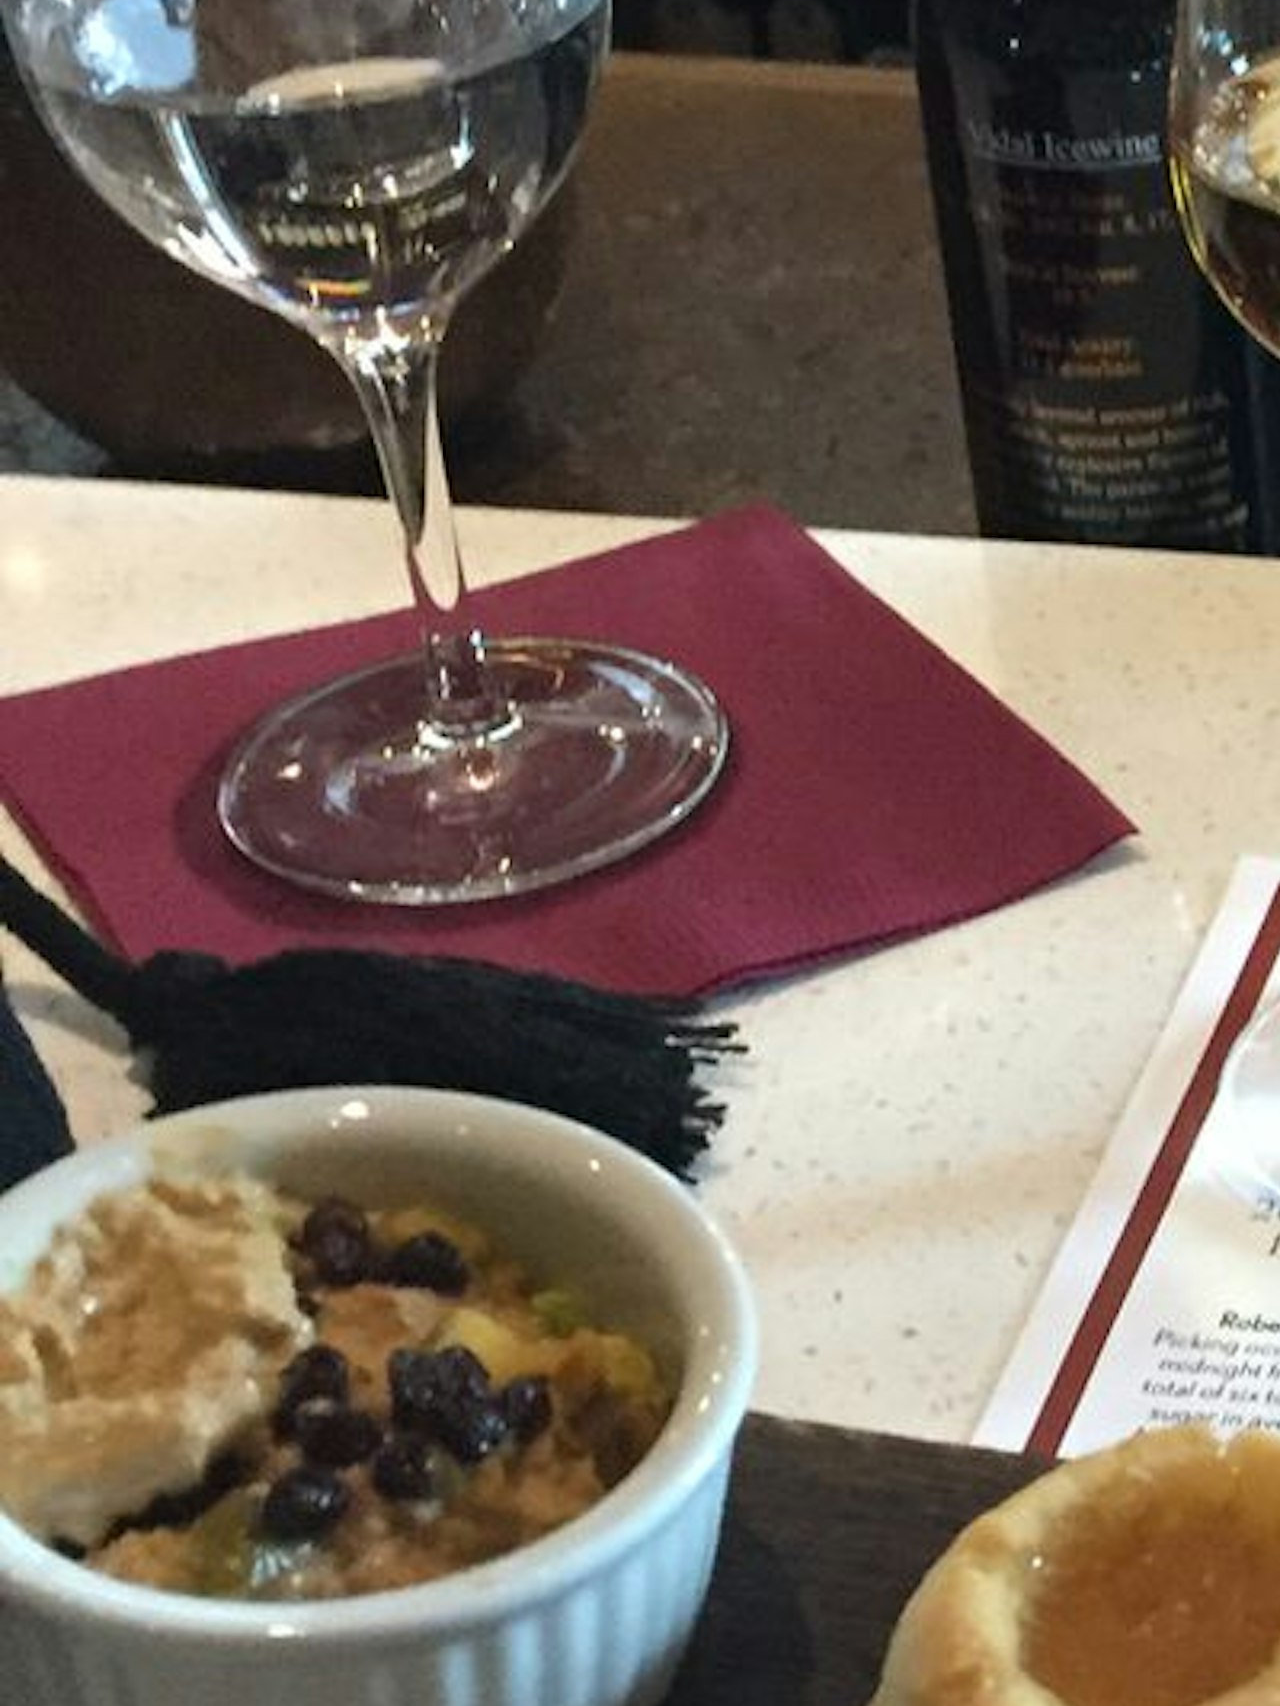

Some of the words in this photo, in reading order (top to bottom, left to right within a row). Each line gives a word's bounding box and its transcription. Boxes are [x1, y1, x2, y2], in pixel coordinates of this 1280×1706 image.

[1043, 131, 1161, 162] Icewine
[1153, 1326, 1239, 1356] Picking
[1157, 1356, 1262, 1383] midnight
[1141, 1378, 1195, 1398] total
[1199, 1383, 1227, 1400] of
